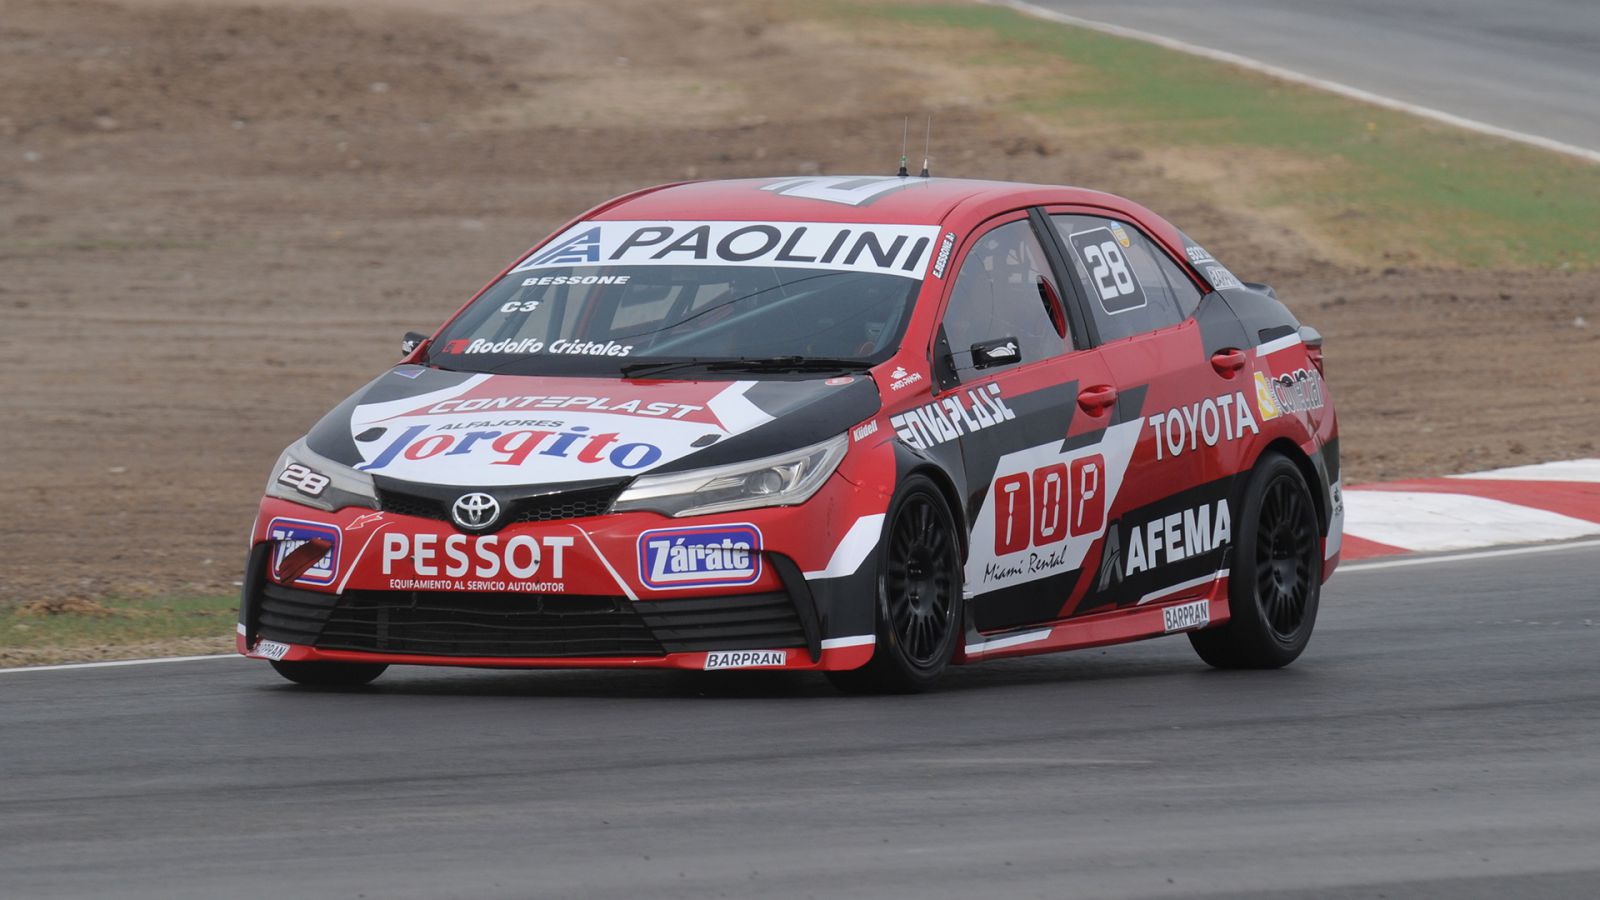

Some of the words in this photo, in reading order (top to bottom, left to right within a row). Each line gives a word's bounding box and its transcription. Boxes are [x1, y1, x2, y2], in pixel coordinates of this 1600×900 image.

[607, 224, 930, 272] PAOLINI
[521, 275, 631, 287] BESSONE
[1083, 240, 1135, 300] 28
[500, 300, 540, 313] C3
[465, 337, 545, 355] Rodolfo
[549, 338, 634, 357] Cristales
[426, 396, 704, 419] CONTEPLAST
[437, 419, 566, 432] ALFAJORES
[1149, 391, 1259, 461] TOYOTA
[355, 424, 663, 471] Jorgito
[279, 463, 331, 498] 28
[1002, 461, 1100, 547] TOP
[382, 532, 575, 579] PESSOT
[1125, 498, 1232, 577] AFEMA
[649, 537, 752, 582] Zárate
[983, 562, 1024, 583] Miami
[1027, 545, 1067, 574] Rental
[389, 578, 453, 590] EQUIPAMIENTO
[453, 580, 466, 590] AL
[467, 580, 505, 591] SERVICIO
[507, 581, 565, 592] AUTOMOTOR
[1164, 601, 1208, 631] BARPRAN
[706, 652, 782, 668] BARPRAN
